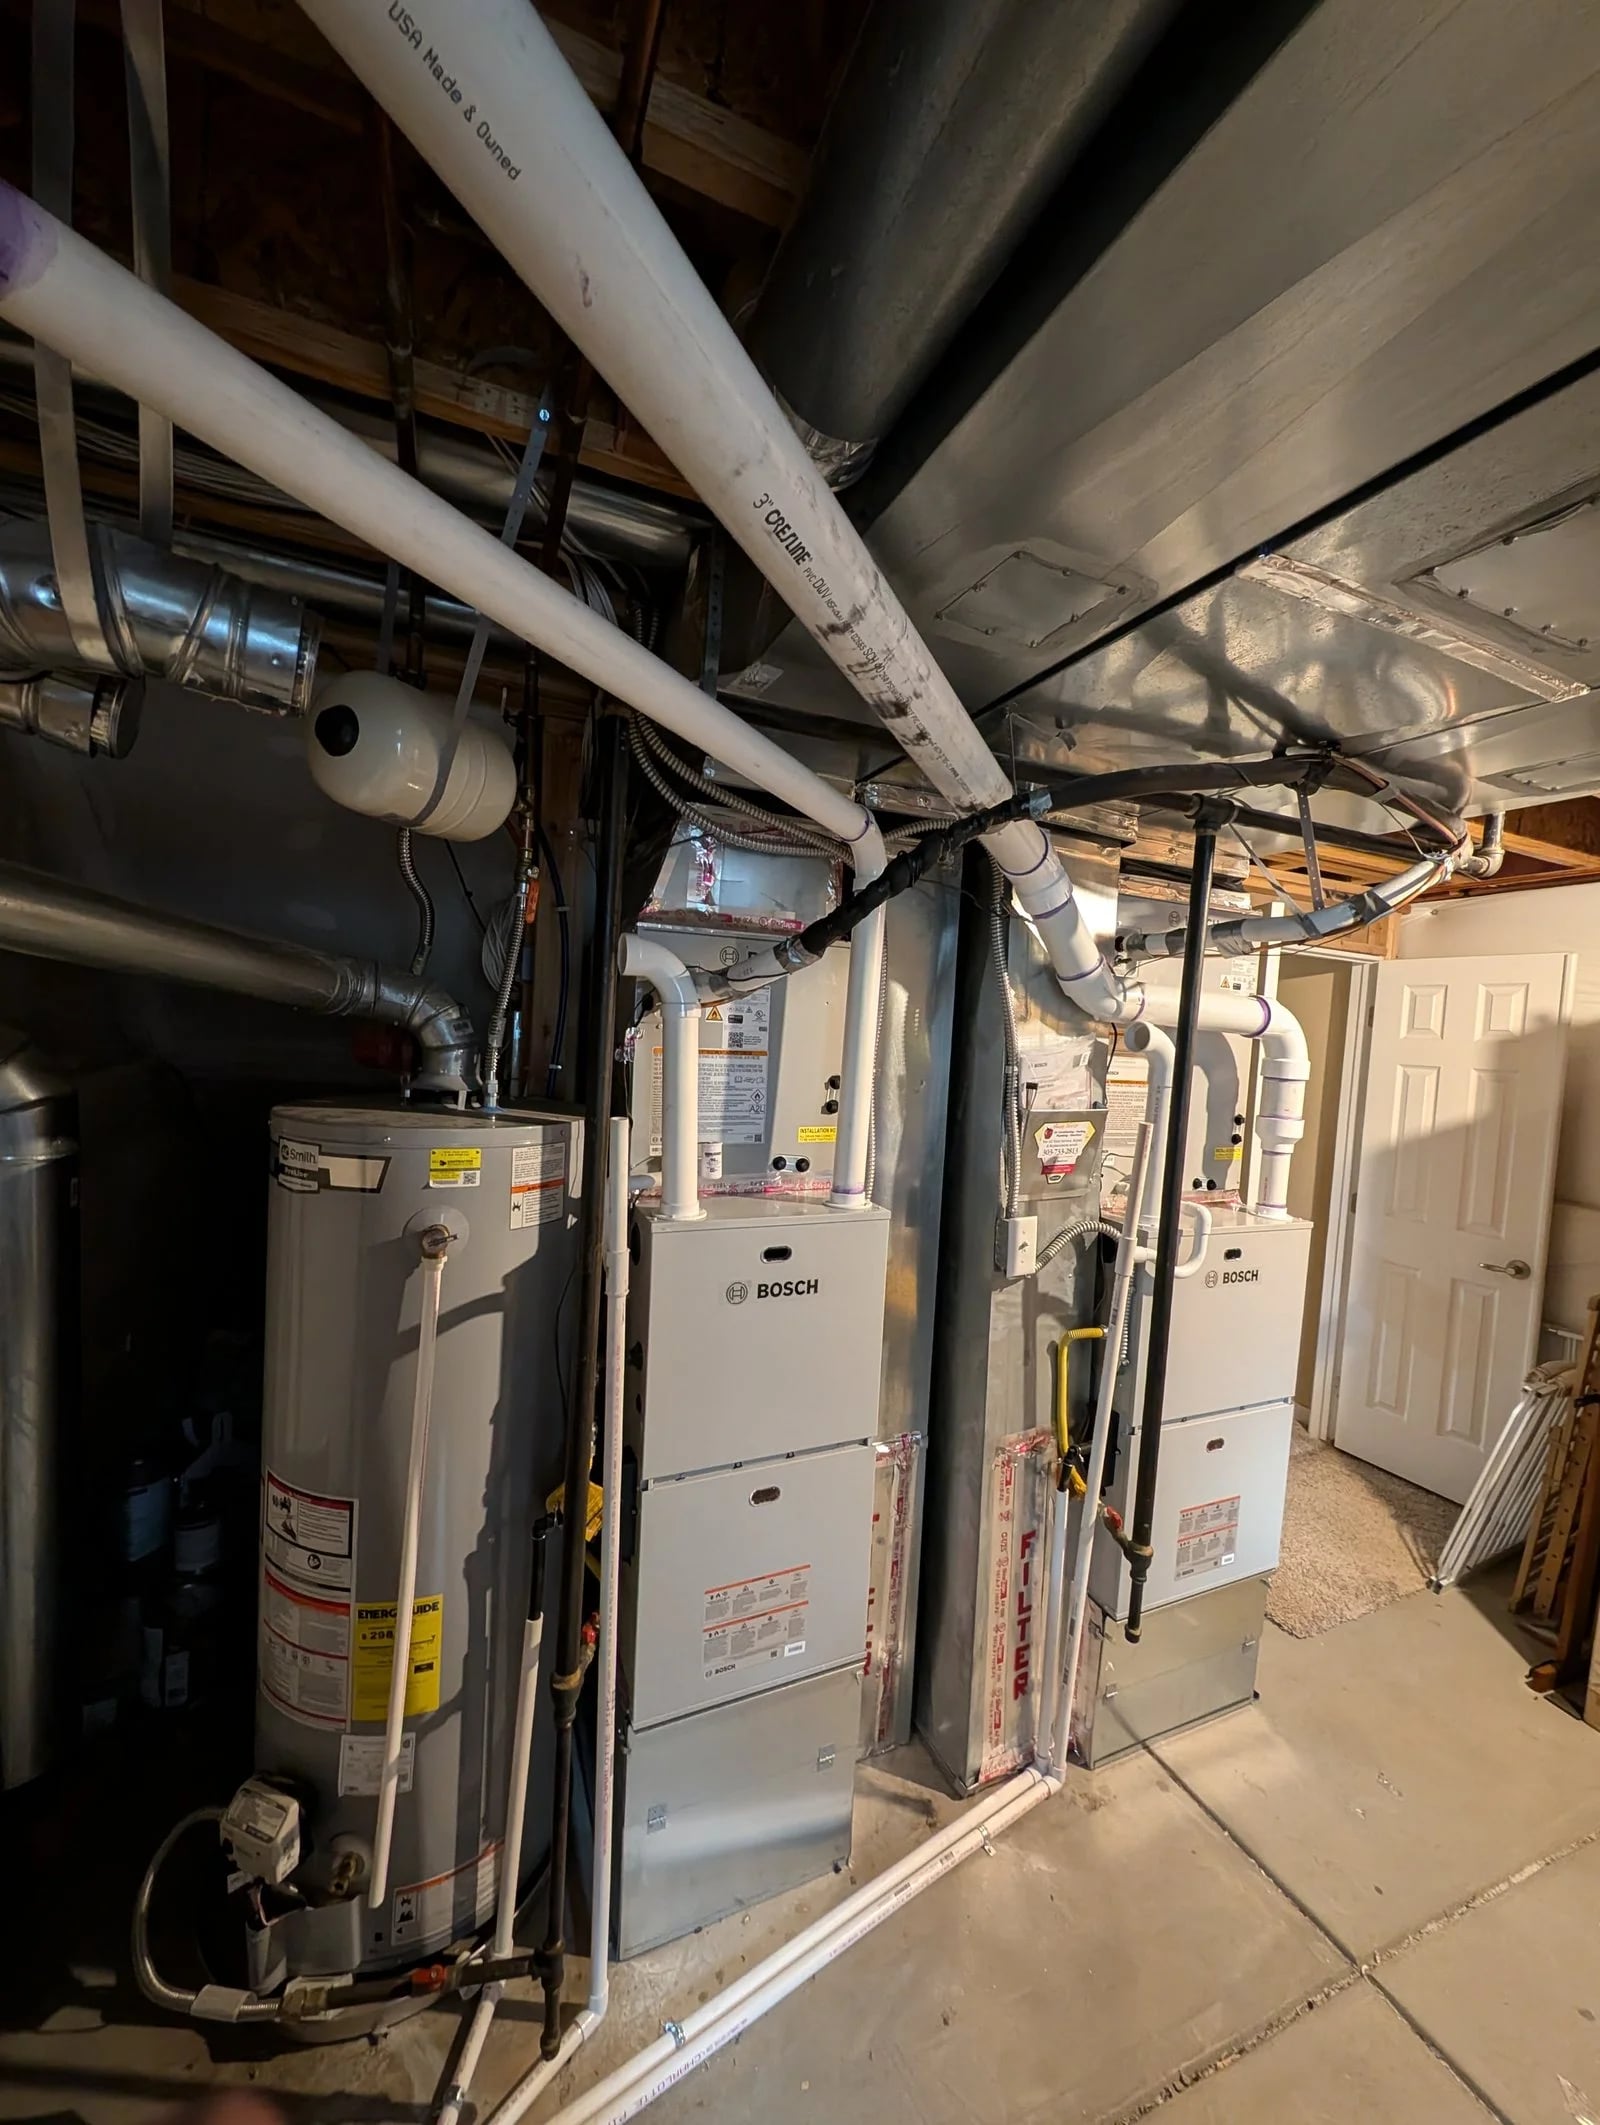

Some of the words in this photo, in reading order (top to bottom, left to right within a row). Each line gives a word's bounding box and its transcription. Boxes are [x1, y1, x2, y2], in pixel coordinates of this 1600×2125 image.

[388, 0, 423, 49] USA
[423, 48, 462, 104] Made
[464, 105, 476, 122] &
[476, 121, 521, 180] Owned
[803, 567, 817, 582] PVC
[812, 578, 833, 599] DWV
[863, 648, 879, 664] SCH
[751, 1105, 765, 1113] A2L
[1223, 1269, 1258, 1284] BOSCH
[757, 1279, 818, 1299] BOSCH
[358, 1601, 439, 1619] ENERGUIDE
[1013, 1529, 1036, 1701] FILTER
[714, 1663, 736, 1675] BOSCH
